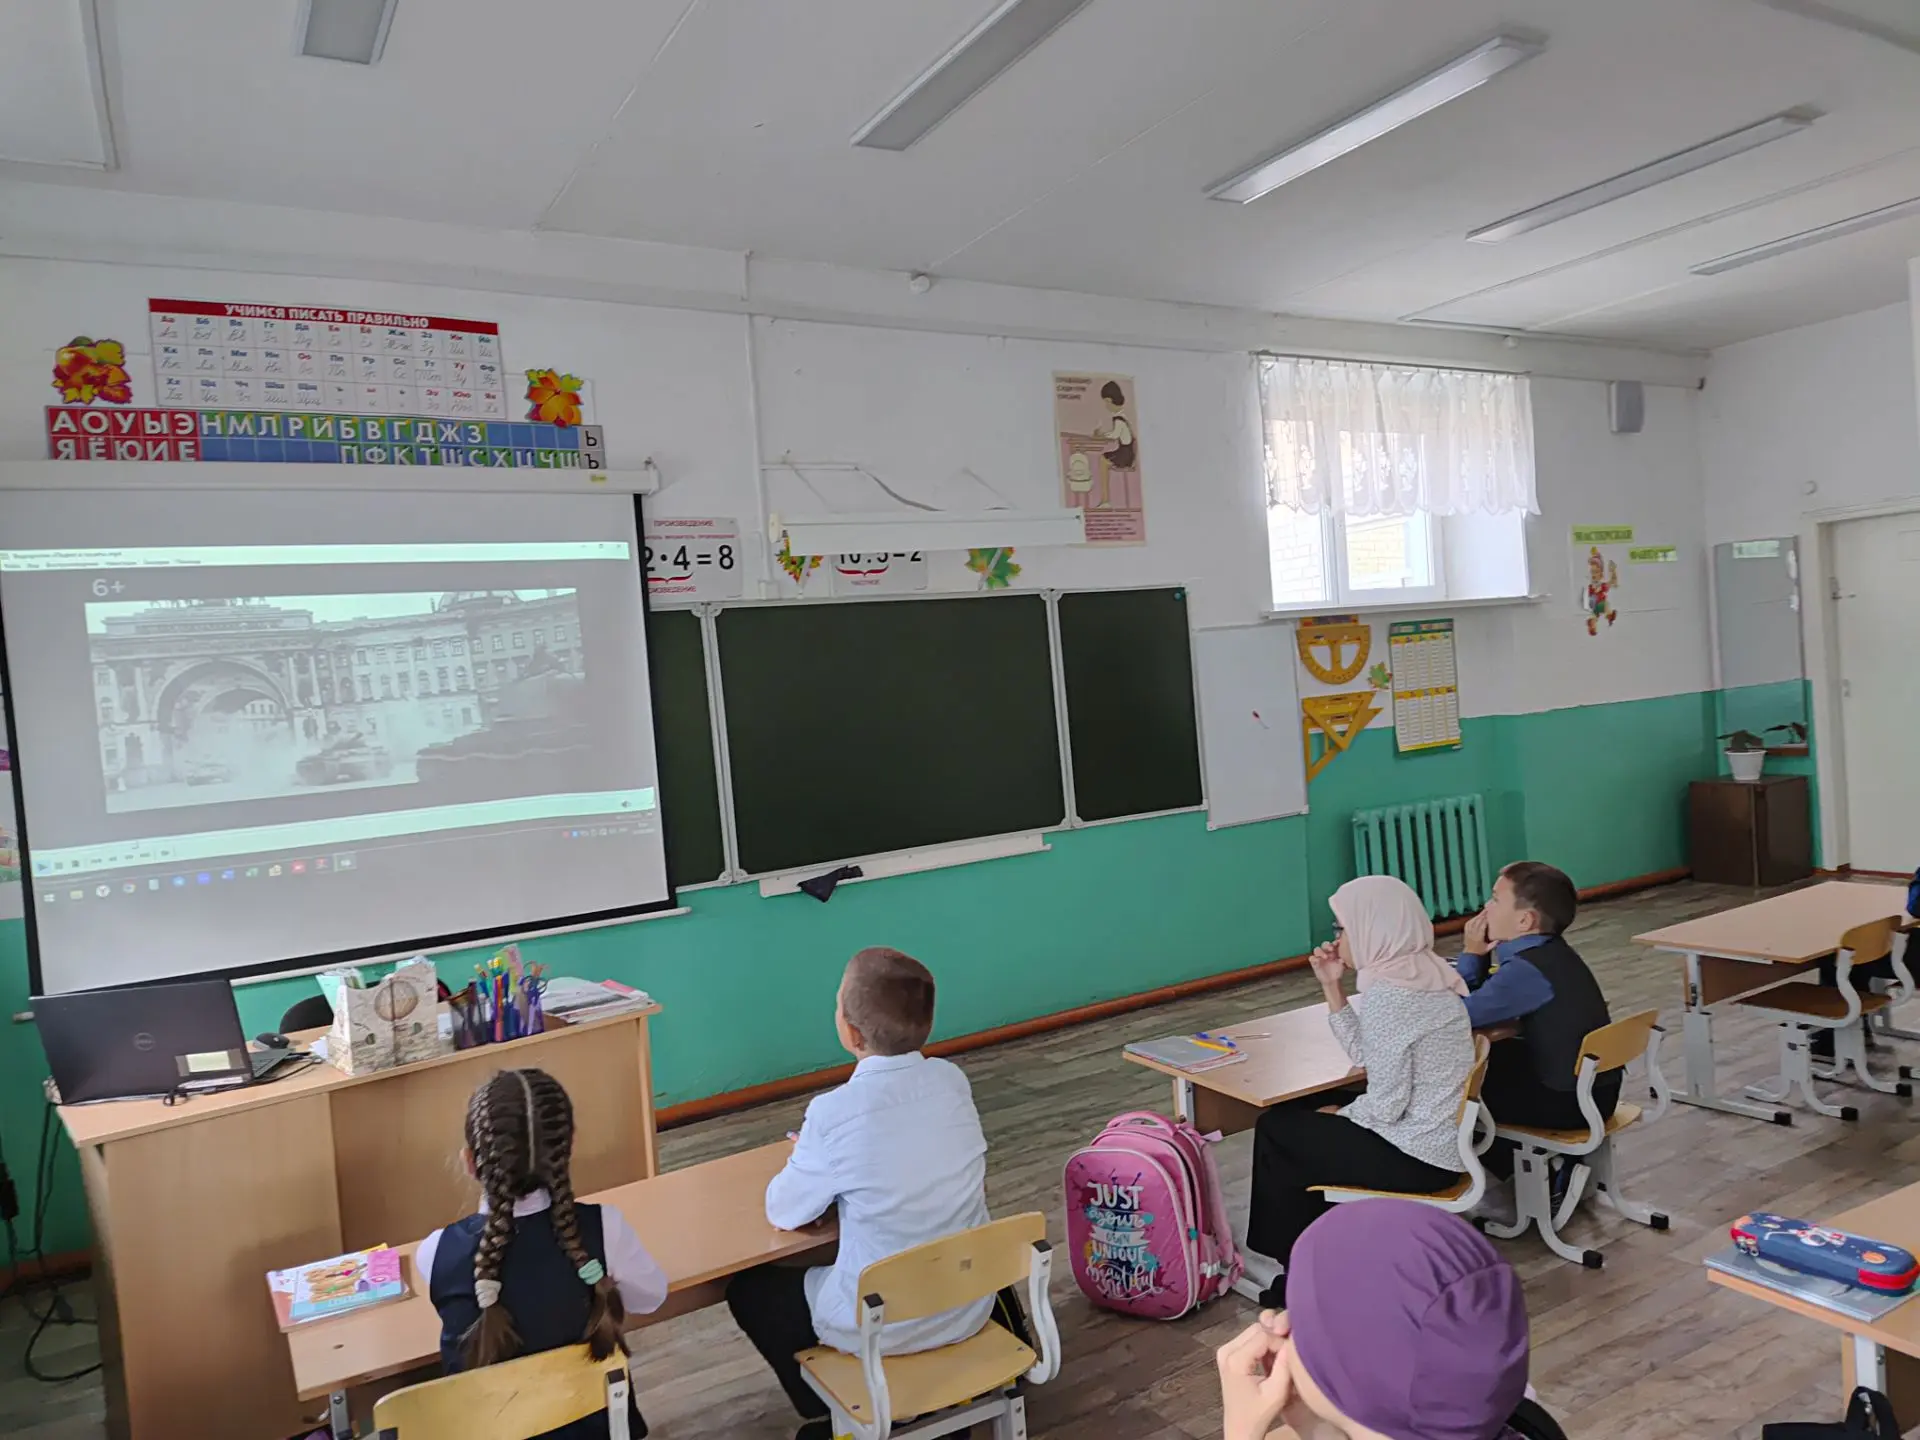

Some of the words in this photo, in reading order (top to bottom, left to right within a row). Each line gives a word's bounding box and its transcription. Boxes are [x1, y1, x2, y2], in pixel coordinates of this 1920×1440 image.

[224, 304, 286, 318] УЧИМСЯ
[288, 306, 344, 322] ПИСАТЬ
[347, 312, 429, 328] ПРАВИЛЬНО
[92, 578, 125, 597] 6+
[1087, 1182, 1145, 1210] JUST
